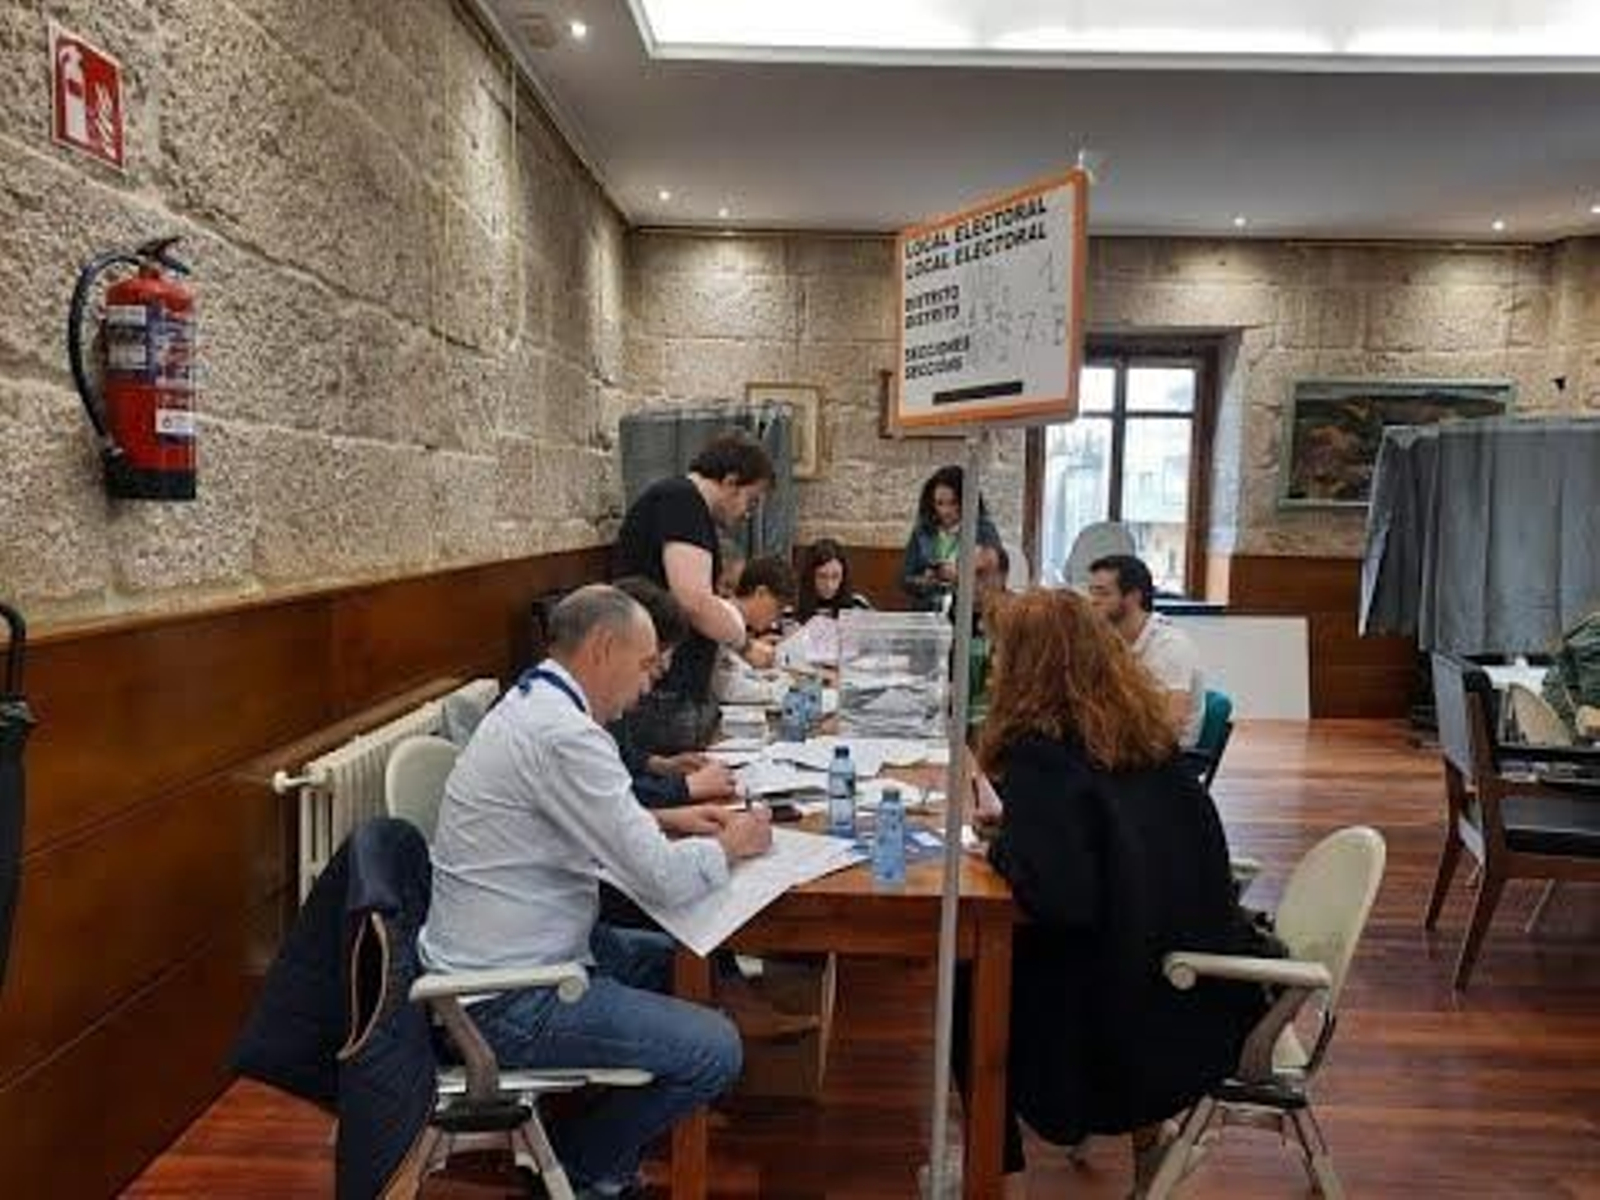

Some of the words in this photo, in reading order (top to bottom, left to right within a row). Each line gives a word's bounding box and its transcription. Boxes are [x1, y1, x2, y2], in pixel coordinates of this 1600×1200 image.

[905, 231, 950, 258] LOCAL
[955, 196, 1048, 243] ELECTORAL
[905, 252, 950, 280] LOCAL
[955, 222, 1047, 265] ELECTORAL
[905, 285, 959, 313] DISTRITO
[905, 304, 959, 330] DISTRITO
[905, 335, 969, 363] SECCIONES
